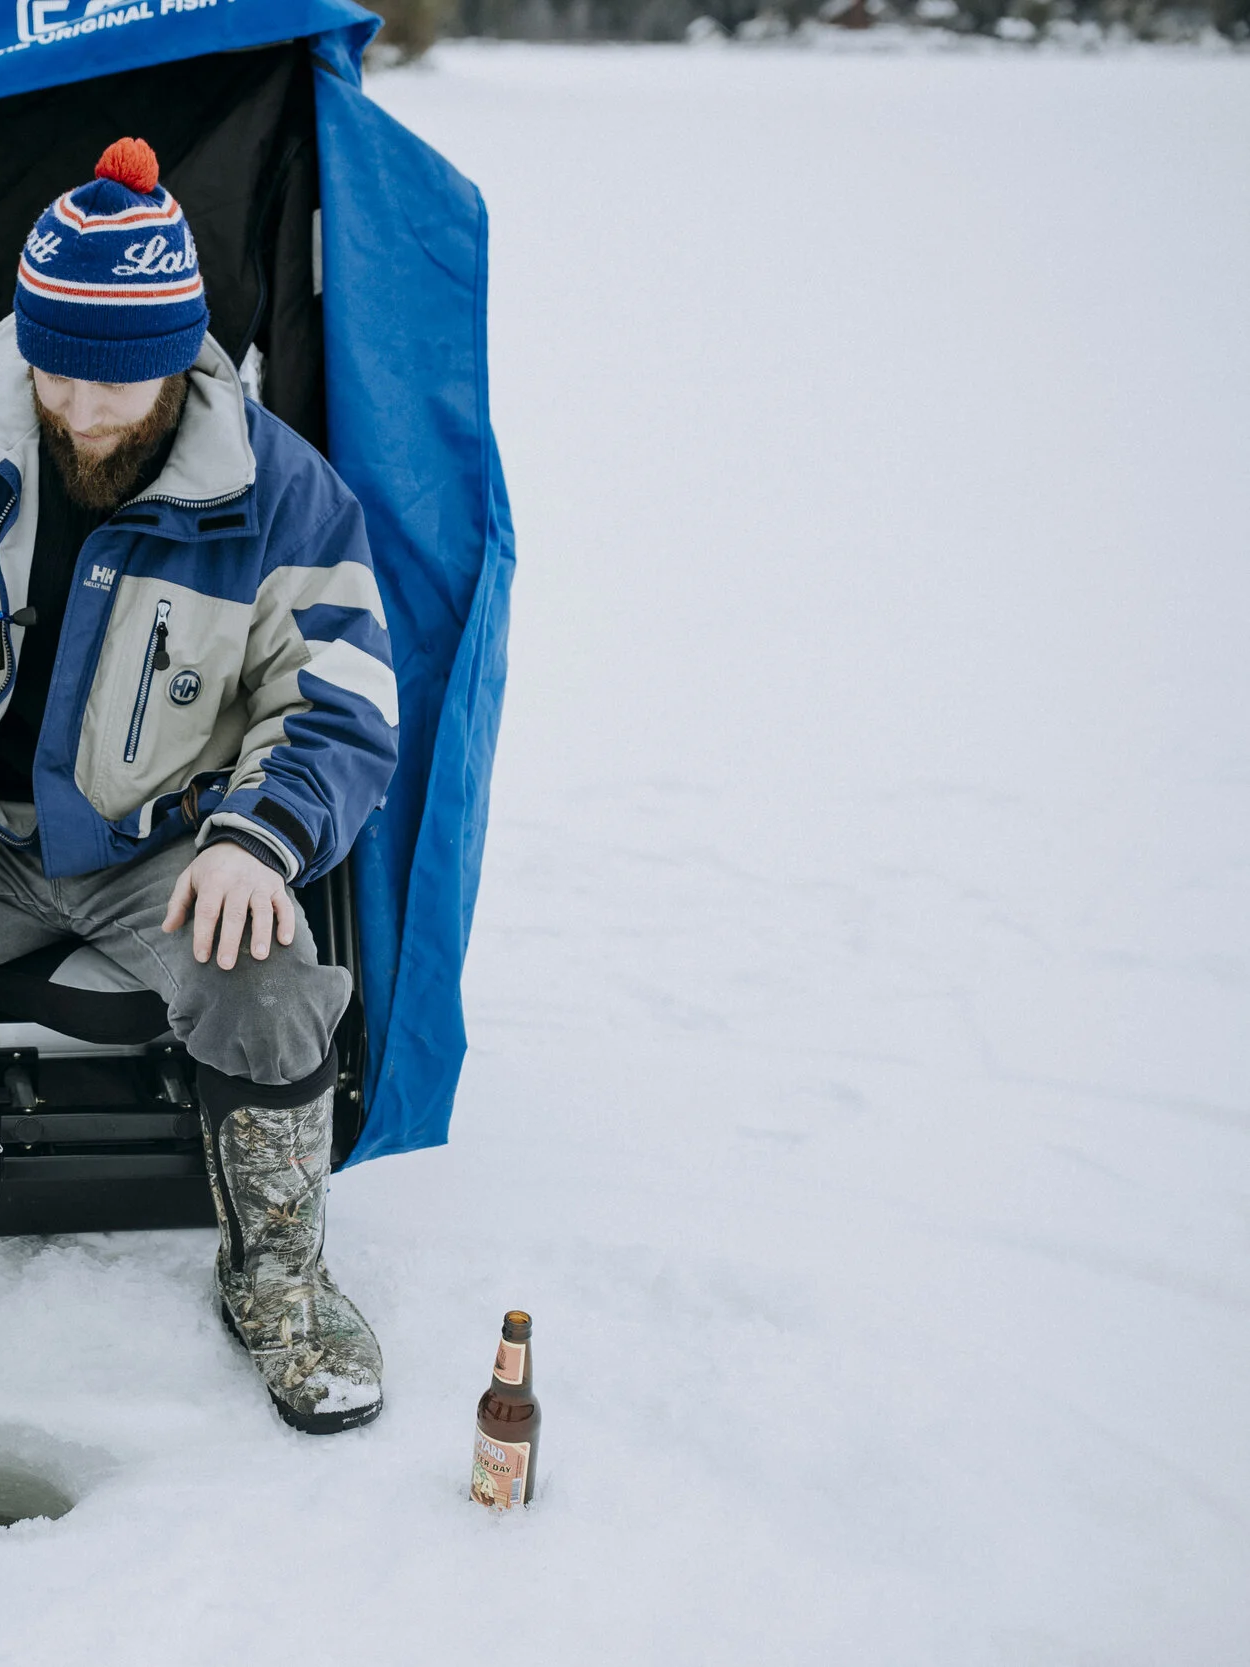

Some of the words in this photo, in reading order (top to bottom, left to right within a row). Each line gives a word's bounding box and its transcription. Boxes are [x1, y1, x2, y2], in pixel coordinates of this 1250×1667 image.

[37, 2, 154, 45] ORIGINAL
[91, 564, 118, 585] HH
[492, 1463, 512, 1474] DAY
